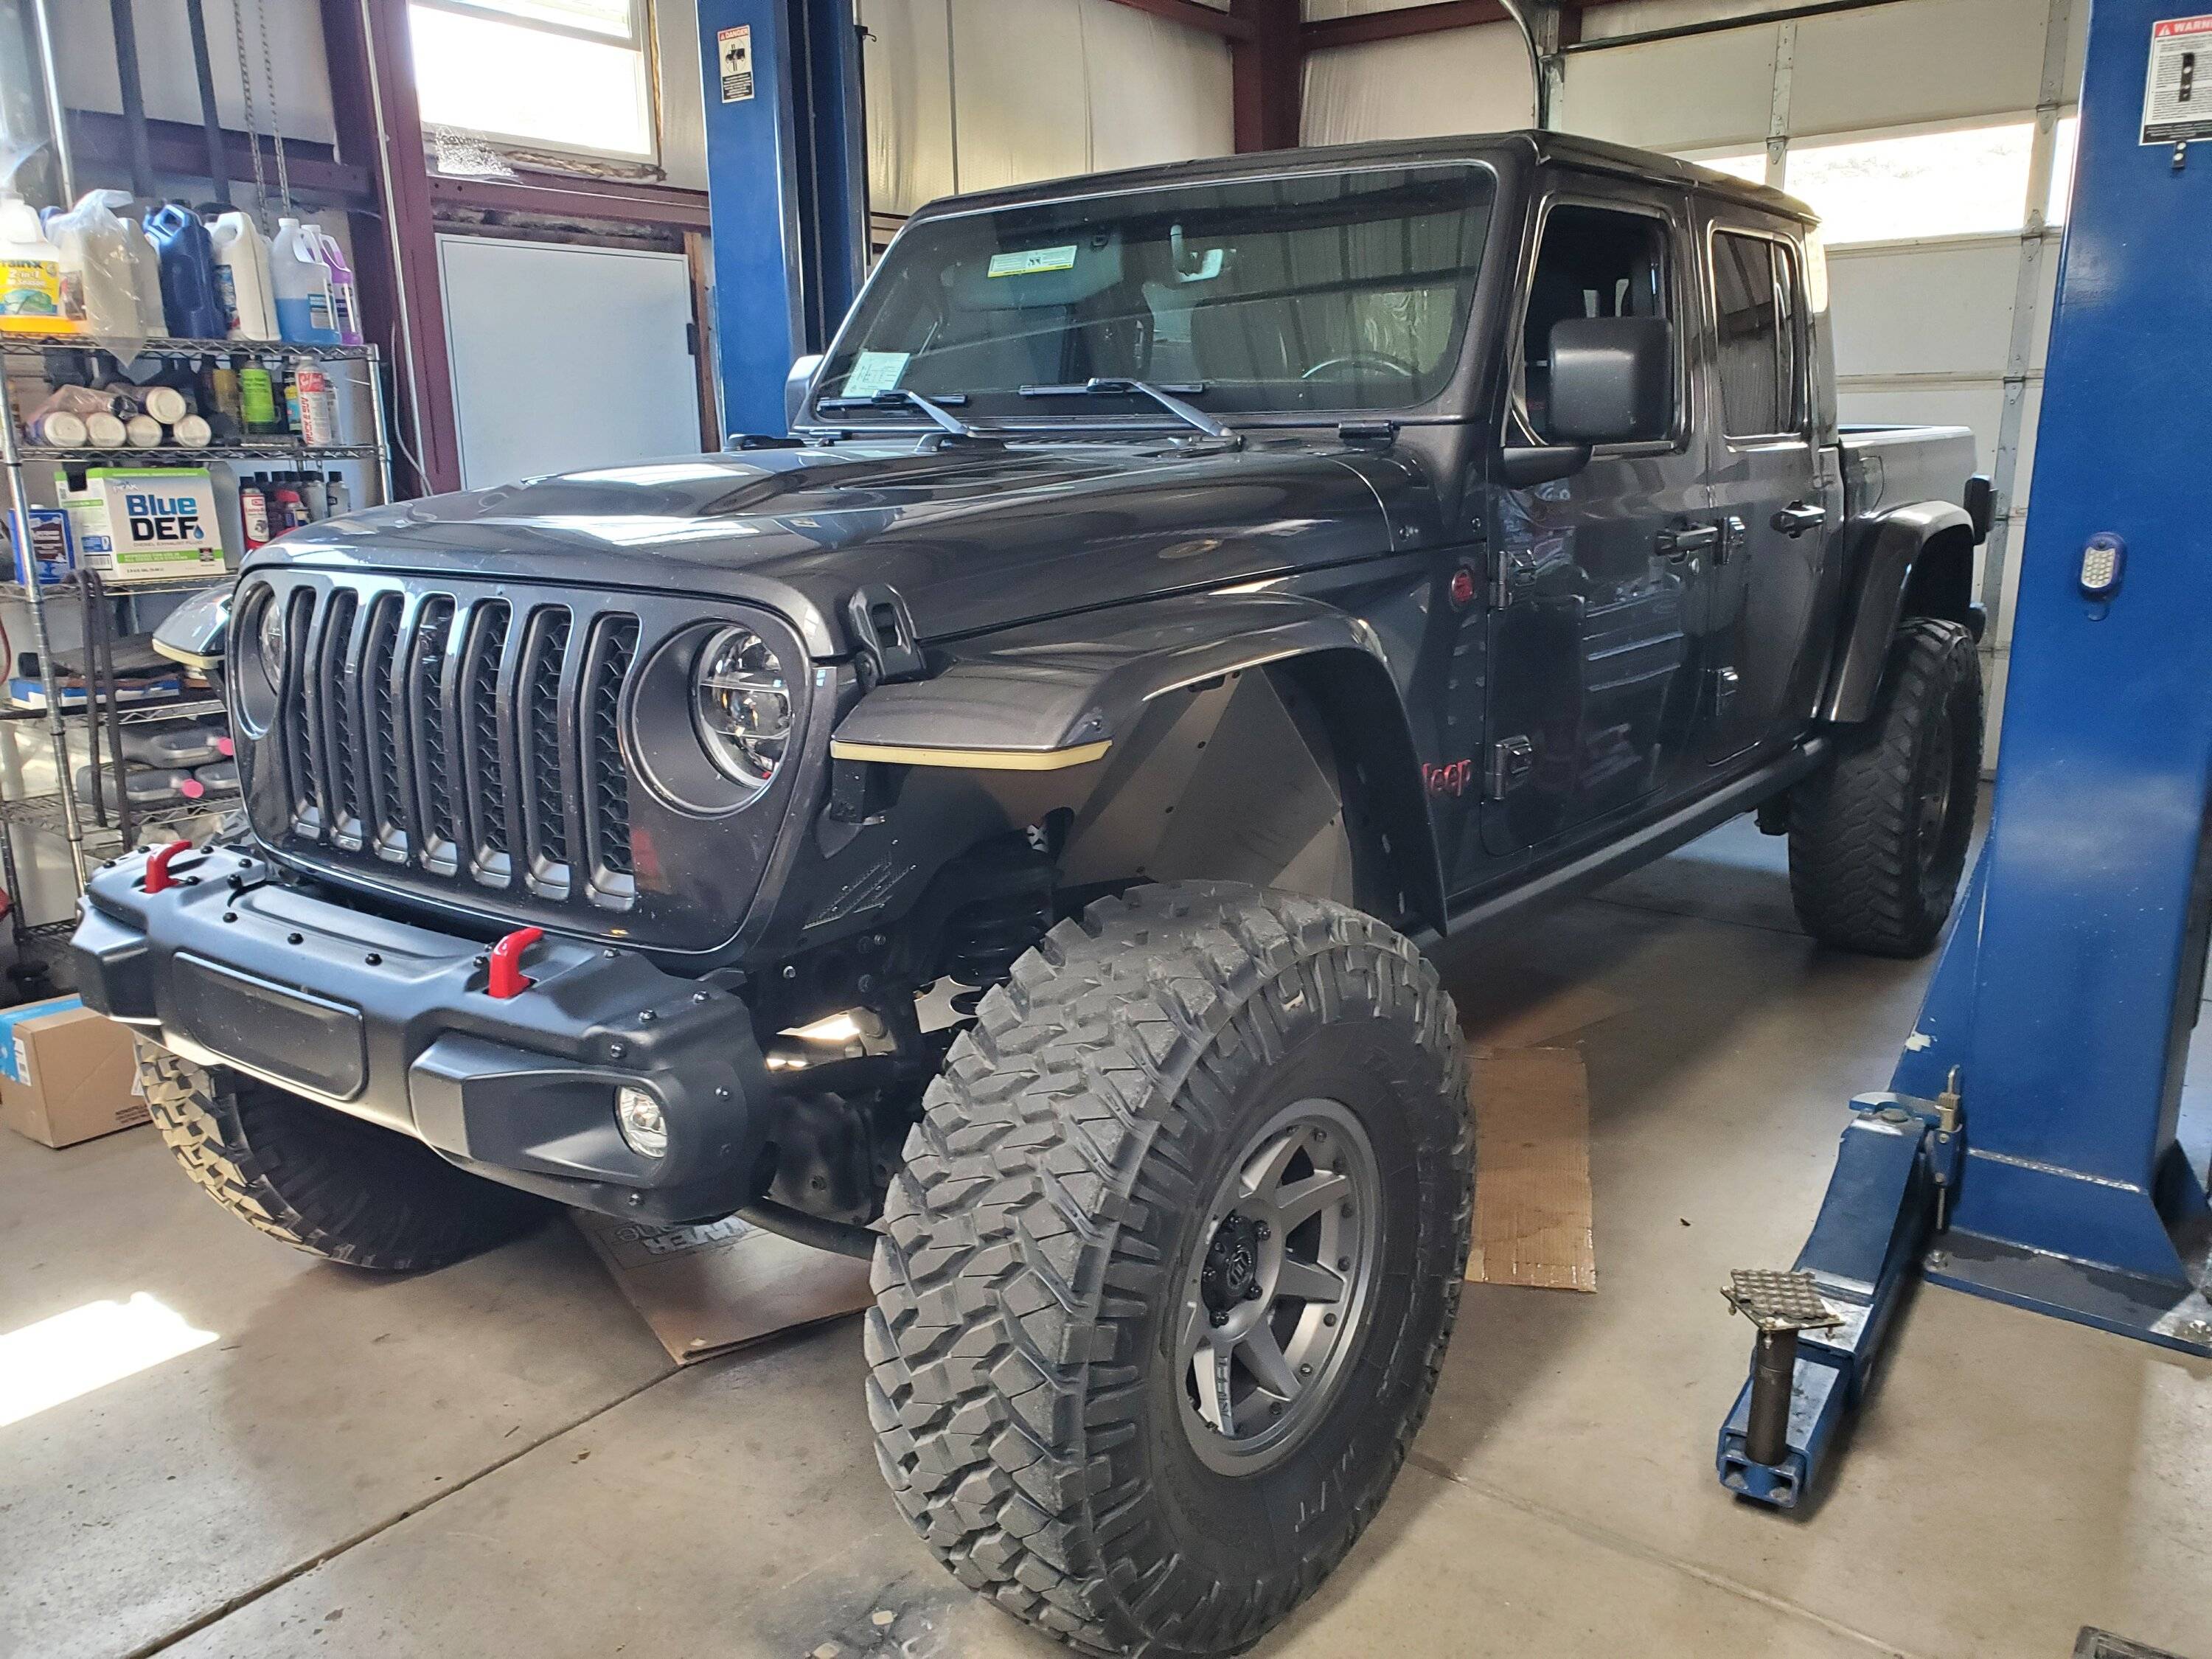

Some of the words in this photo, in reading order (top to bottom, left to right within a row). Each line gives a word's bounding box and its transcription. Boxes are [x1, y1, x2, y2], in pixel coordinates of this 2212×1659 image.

[725, 28, 748, 38] DANGER
[2174, 20, 2212, 32] WARN
[125, 495, 198, 515] Blue
[130, 516, 198, 541] DEF
[1422, 759, 1472, 797] Jeep
